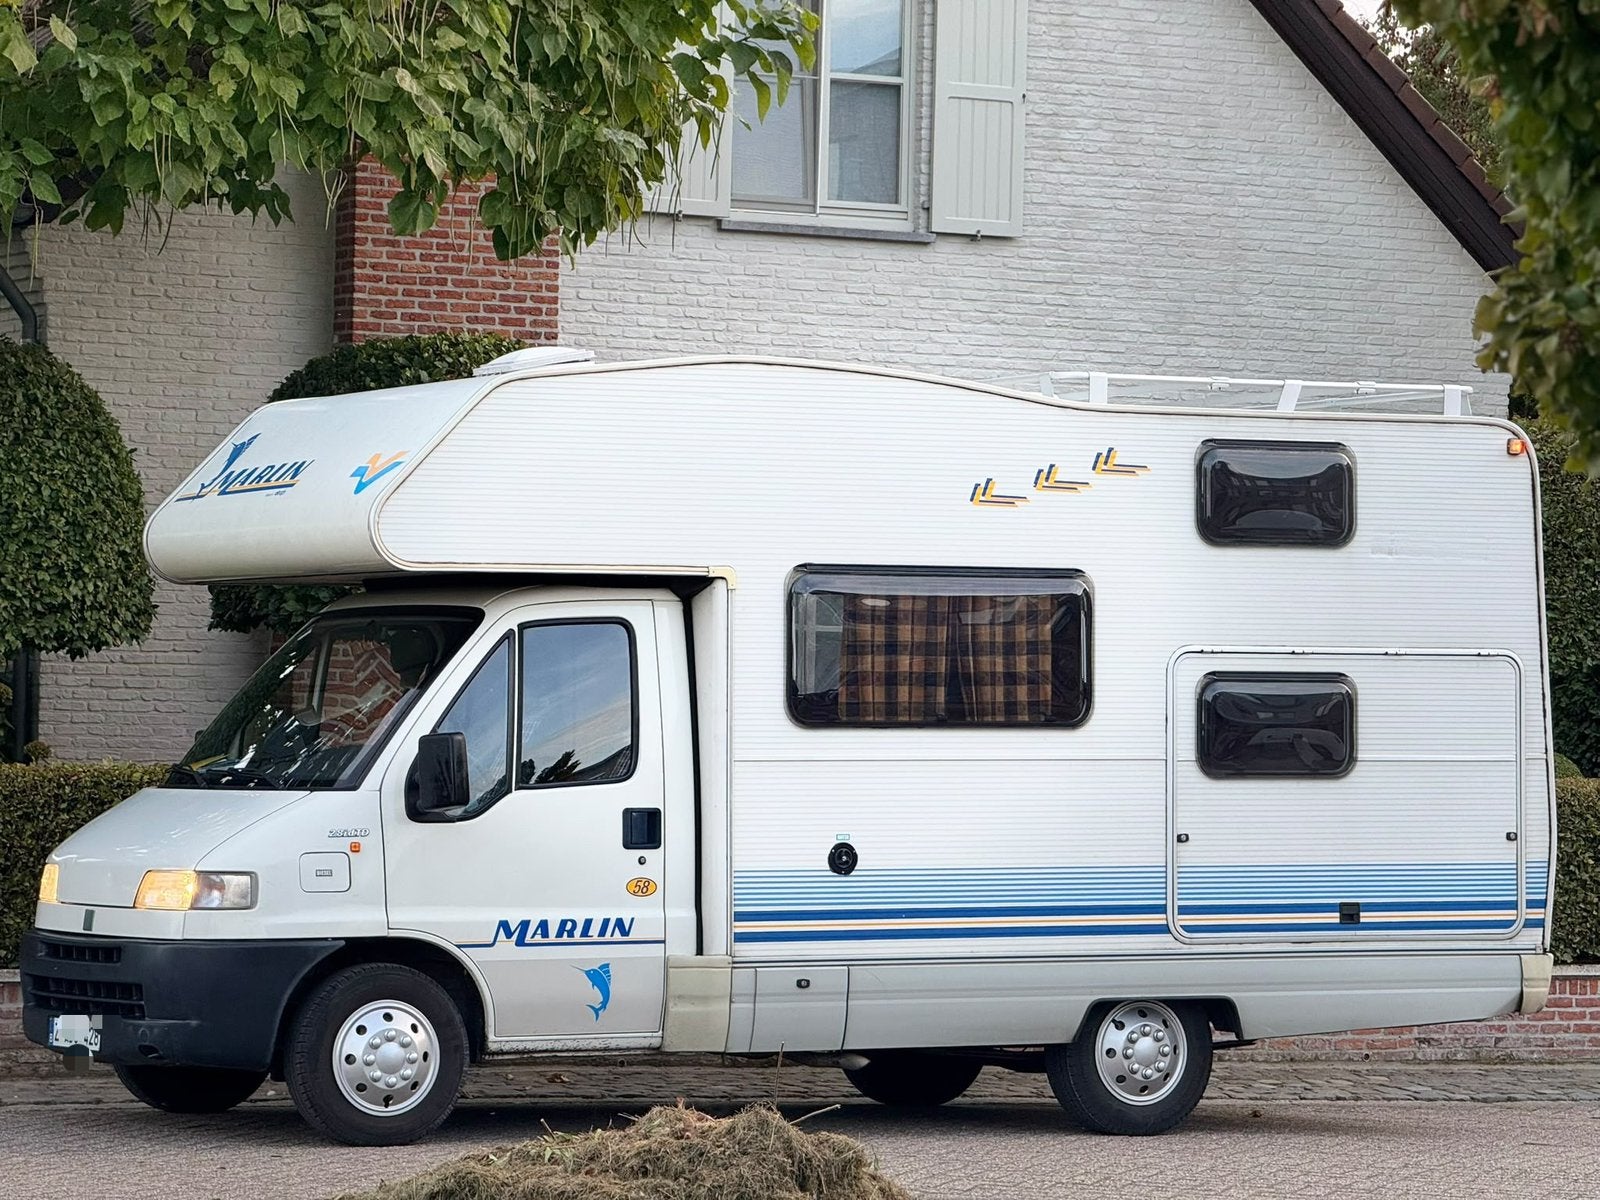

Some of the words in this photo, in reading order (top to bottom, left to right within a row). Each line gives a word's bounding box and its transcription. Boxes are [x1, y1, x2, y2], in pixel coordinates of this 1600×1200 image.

[212, 460, 315, 496] MARLIN
[633, 880, 650, 895] 58
[494, 917, 635, 947] MARLIN
